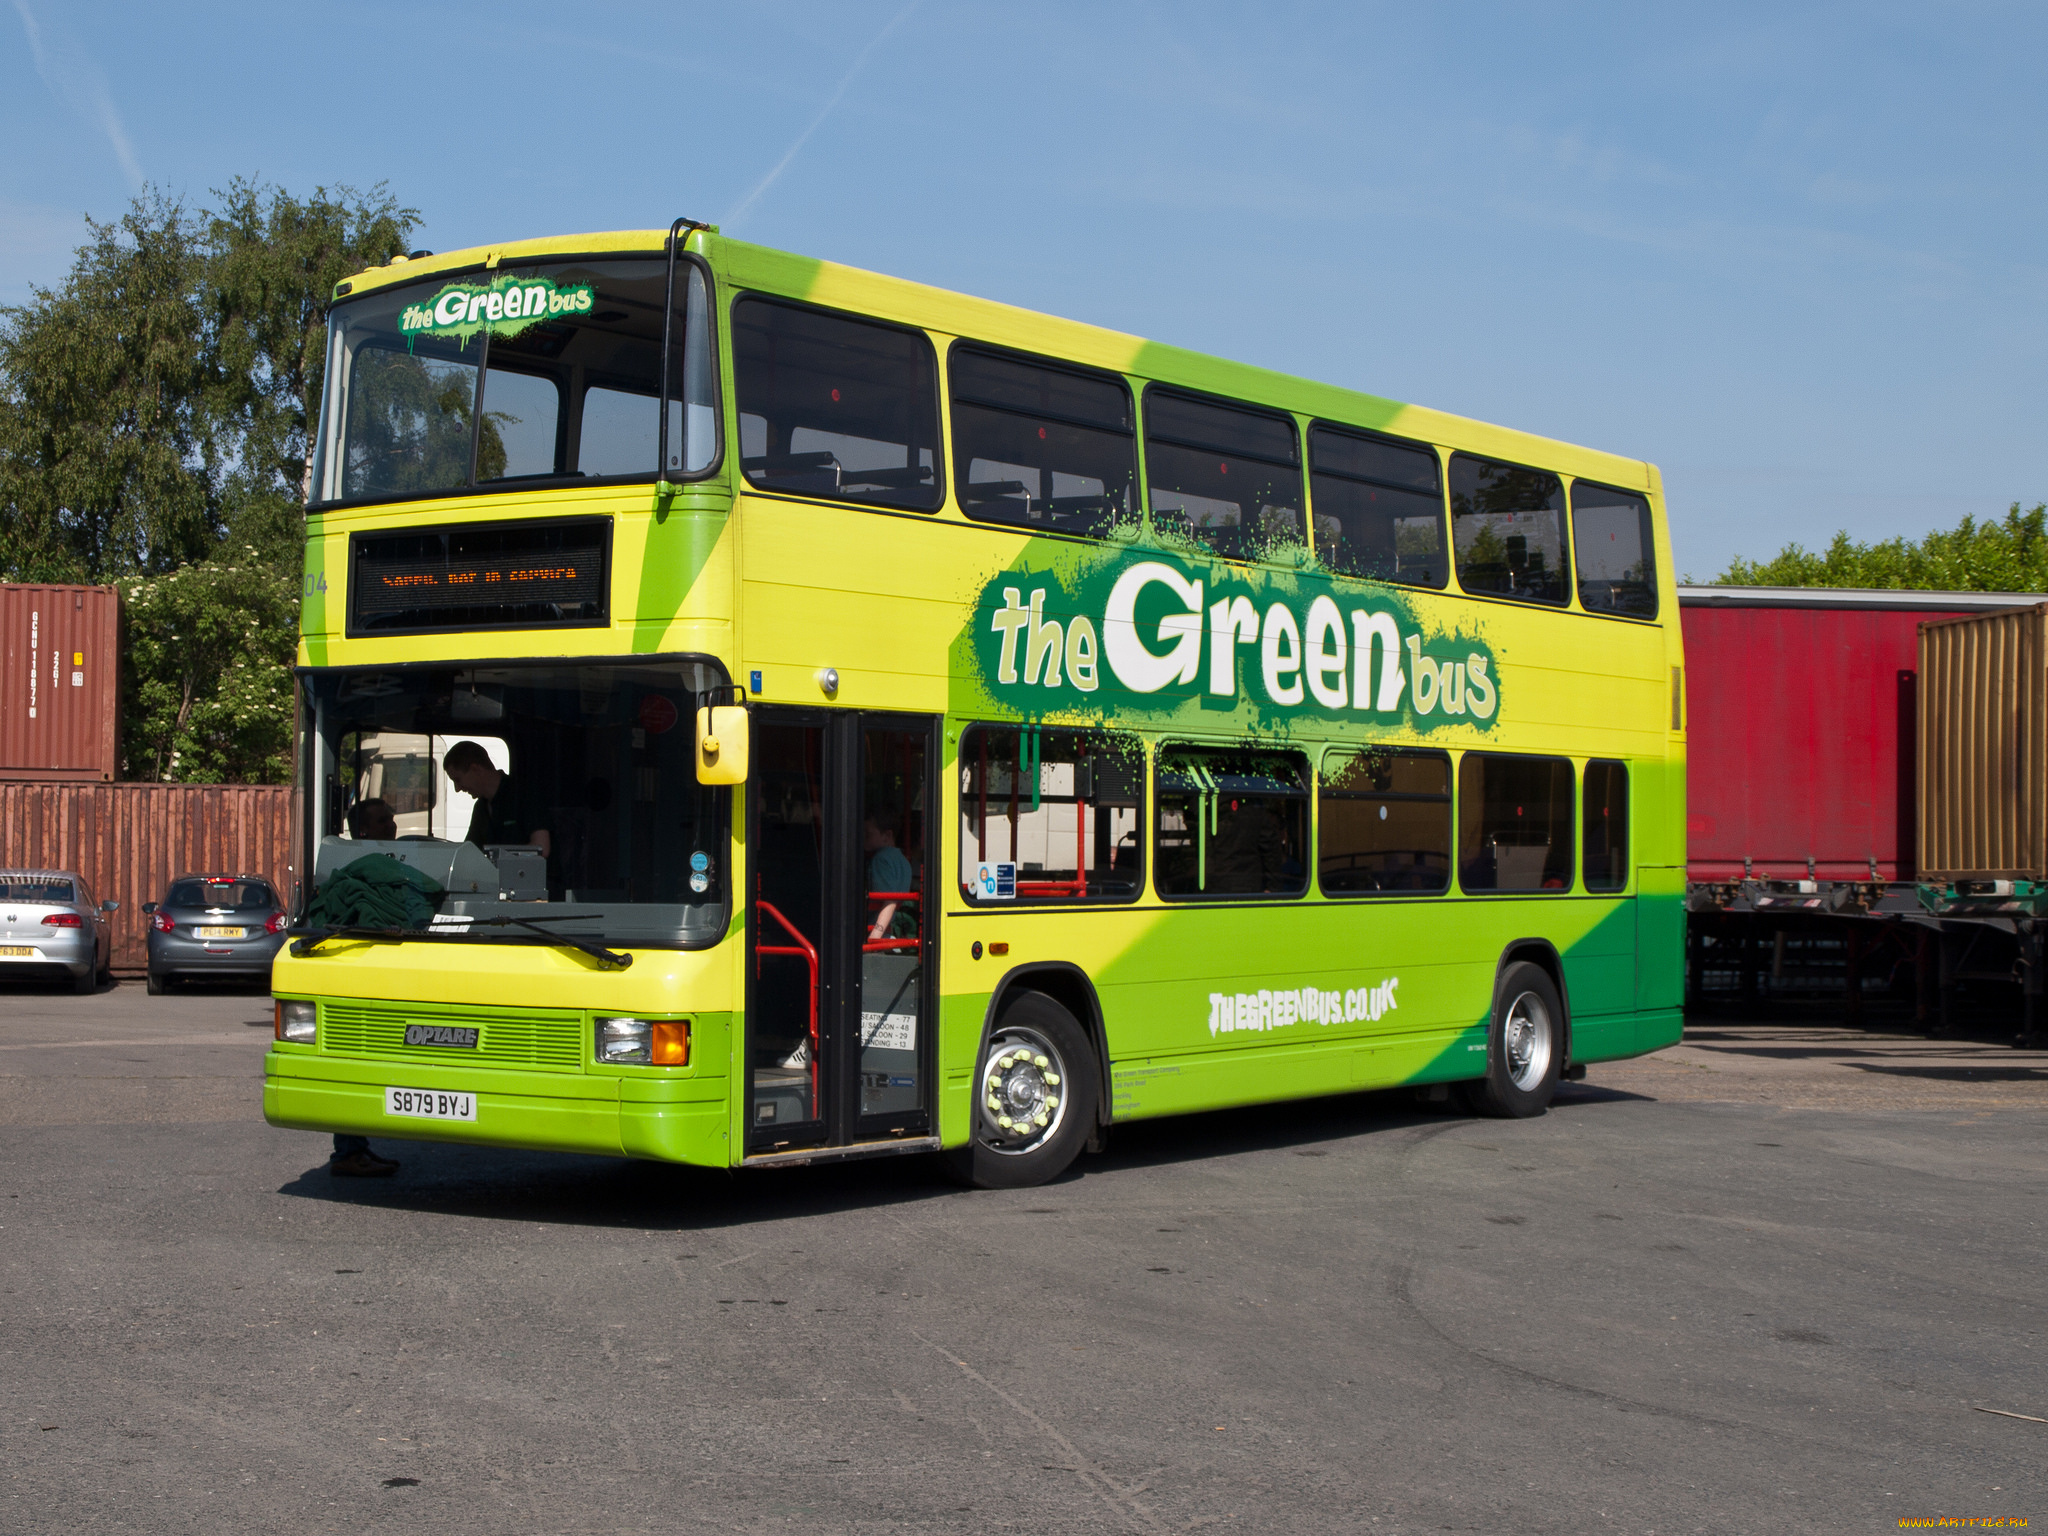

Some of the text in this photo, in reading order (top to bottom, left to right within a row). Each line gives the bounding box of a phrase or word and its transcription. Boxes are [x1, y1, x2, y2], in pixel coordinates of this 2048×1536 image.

[402, 285, 592, 330] the Green bus
[304, 571, 328, 597] 04
[991, 561, 1497, 720] the Green bus
[1208, 976, 1399, 1038] THEGREENBUS.CO.UK
[406, 1025, 477, 1045] OPTARE
[393, 1091, 470, 1116] S879 BYJ
